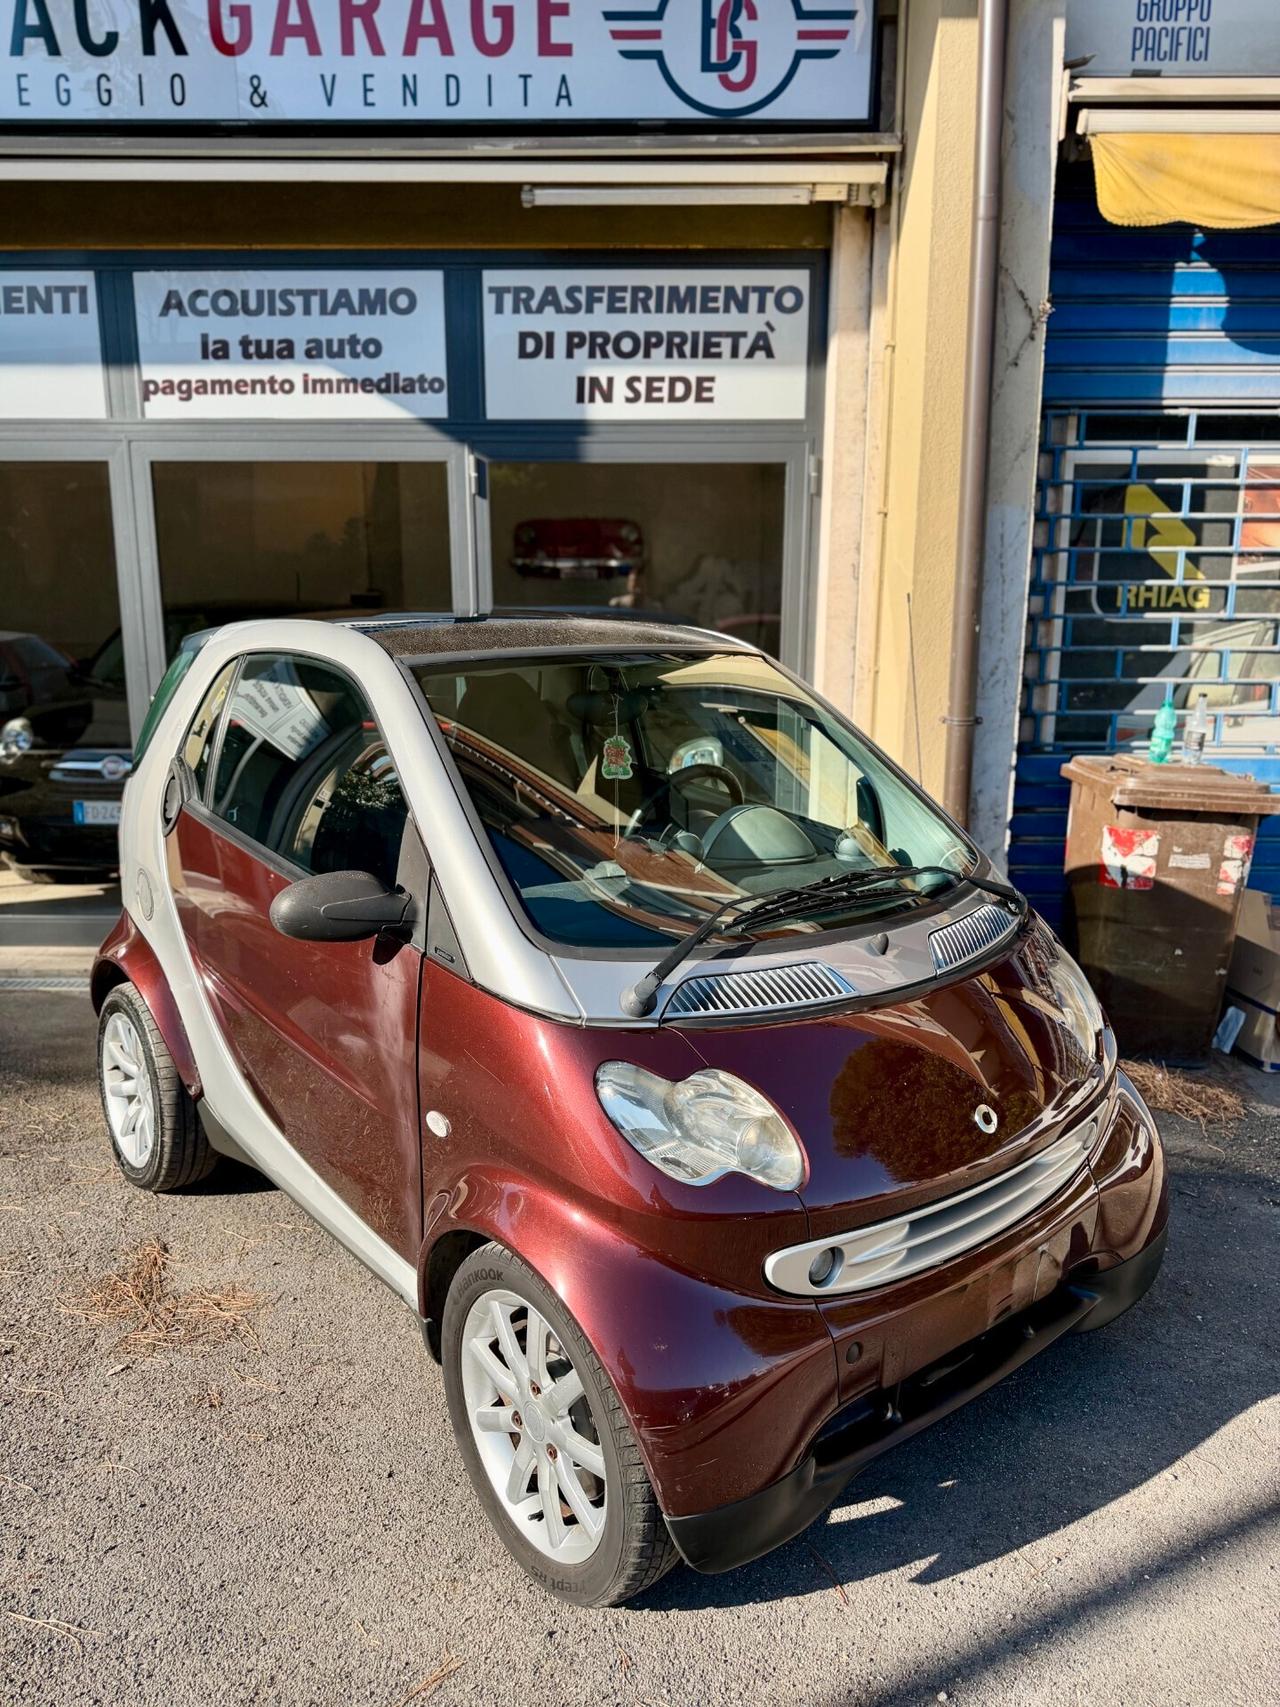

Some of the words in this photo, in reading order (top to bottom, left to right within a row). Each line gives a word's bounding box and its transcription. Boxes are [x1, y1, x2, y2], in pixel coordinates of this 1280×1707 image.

[1136, 0, 1212, 22] GRUPPO
[1131, 26, 1210, 62] PACIFICI
[16, 73, 186, 107] EGGIO
[249, 74, 269, 108] &
[320, 73, 572, 107] VENDITA
[0, 285, 89, 315] ENTI
[158, 287, 417, 317] ACQUISTIAMO
[488, 285, 804, 315] TRASFERIMENTO
[200, 332, 230, 360] la
[239, 334, 295, 360] tua
[304, 333, 383, 360] auto
[517, 331, 554, 359] DI
[565, 320, 776, 360] PROPRIETÀ
[143, 376, 295, 402] pagamento
[302, 372, 445, 396] immediato
[576, 376, 614, 404] IN
[624, 375, 716, 404] SEDE
[1116, 585, 1210, 609] RHIAG
